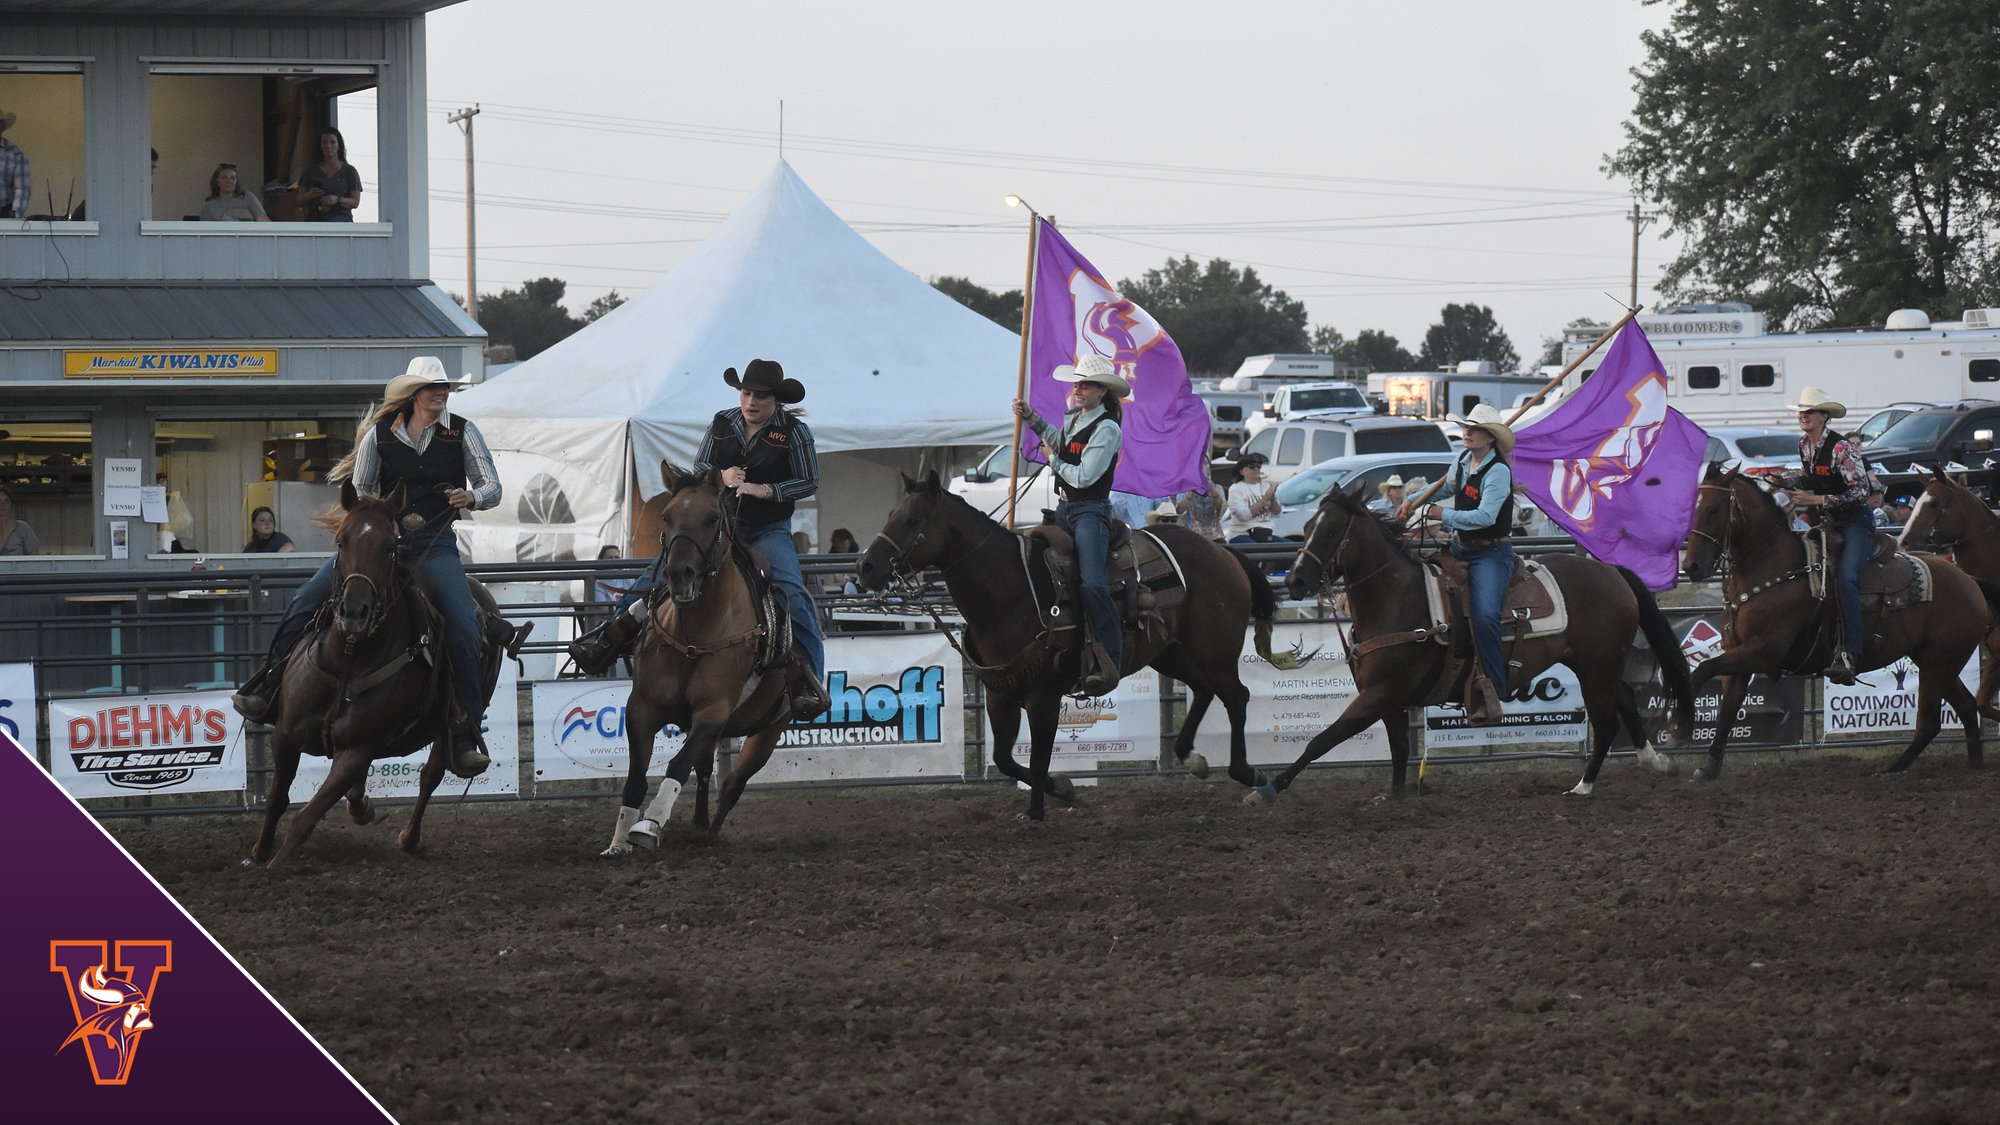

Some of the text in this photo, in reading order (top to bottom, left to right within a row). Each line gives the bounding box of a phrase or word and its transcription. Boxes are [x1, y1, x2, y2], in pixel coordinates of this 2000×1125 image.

[1654, 321, 1729, 333] BLOOMER
[84, 354, 264, 370] Marshall KIWANIS Club
[768, 431, 786, 442] MVC
[1272, 678, 1355, 689] MARTIN HEMENW
[1301, 692, 1349, 701] Representative
[1695, 694, 1719, 707] erial
[1830, 694, 1916, 711] COMMON
[1534, 714, 1572, 722] SALON
[1832, 712, 1910, 728] NATURAL
[67, 704, 228, 751] DIEHM'S
[776, 726, 898, 746] ONSTRUCTION
[79, 750, 211, 770] Tire Service
[119, 770, 184, 783] Since 1969
